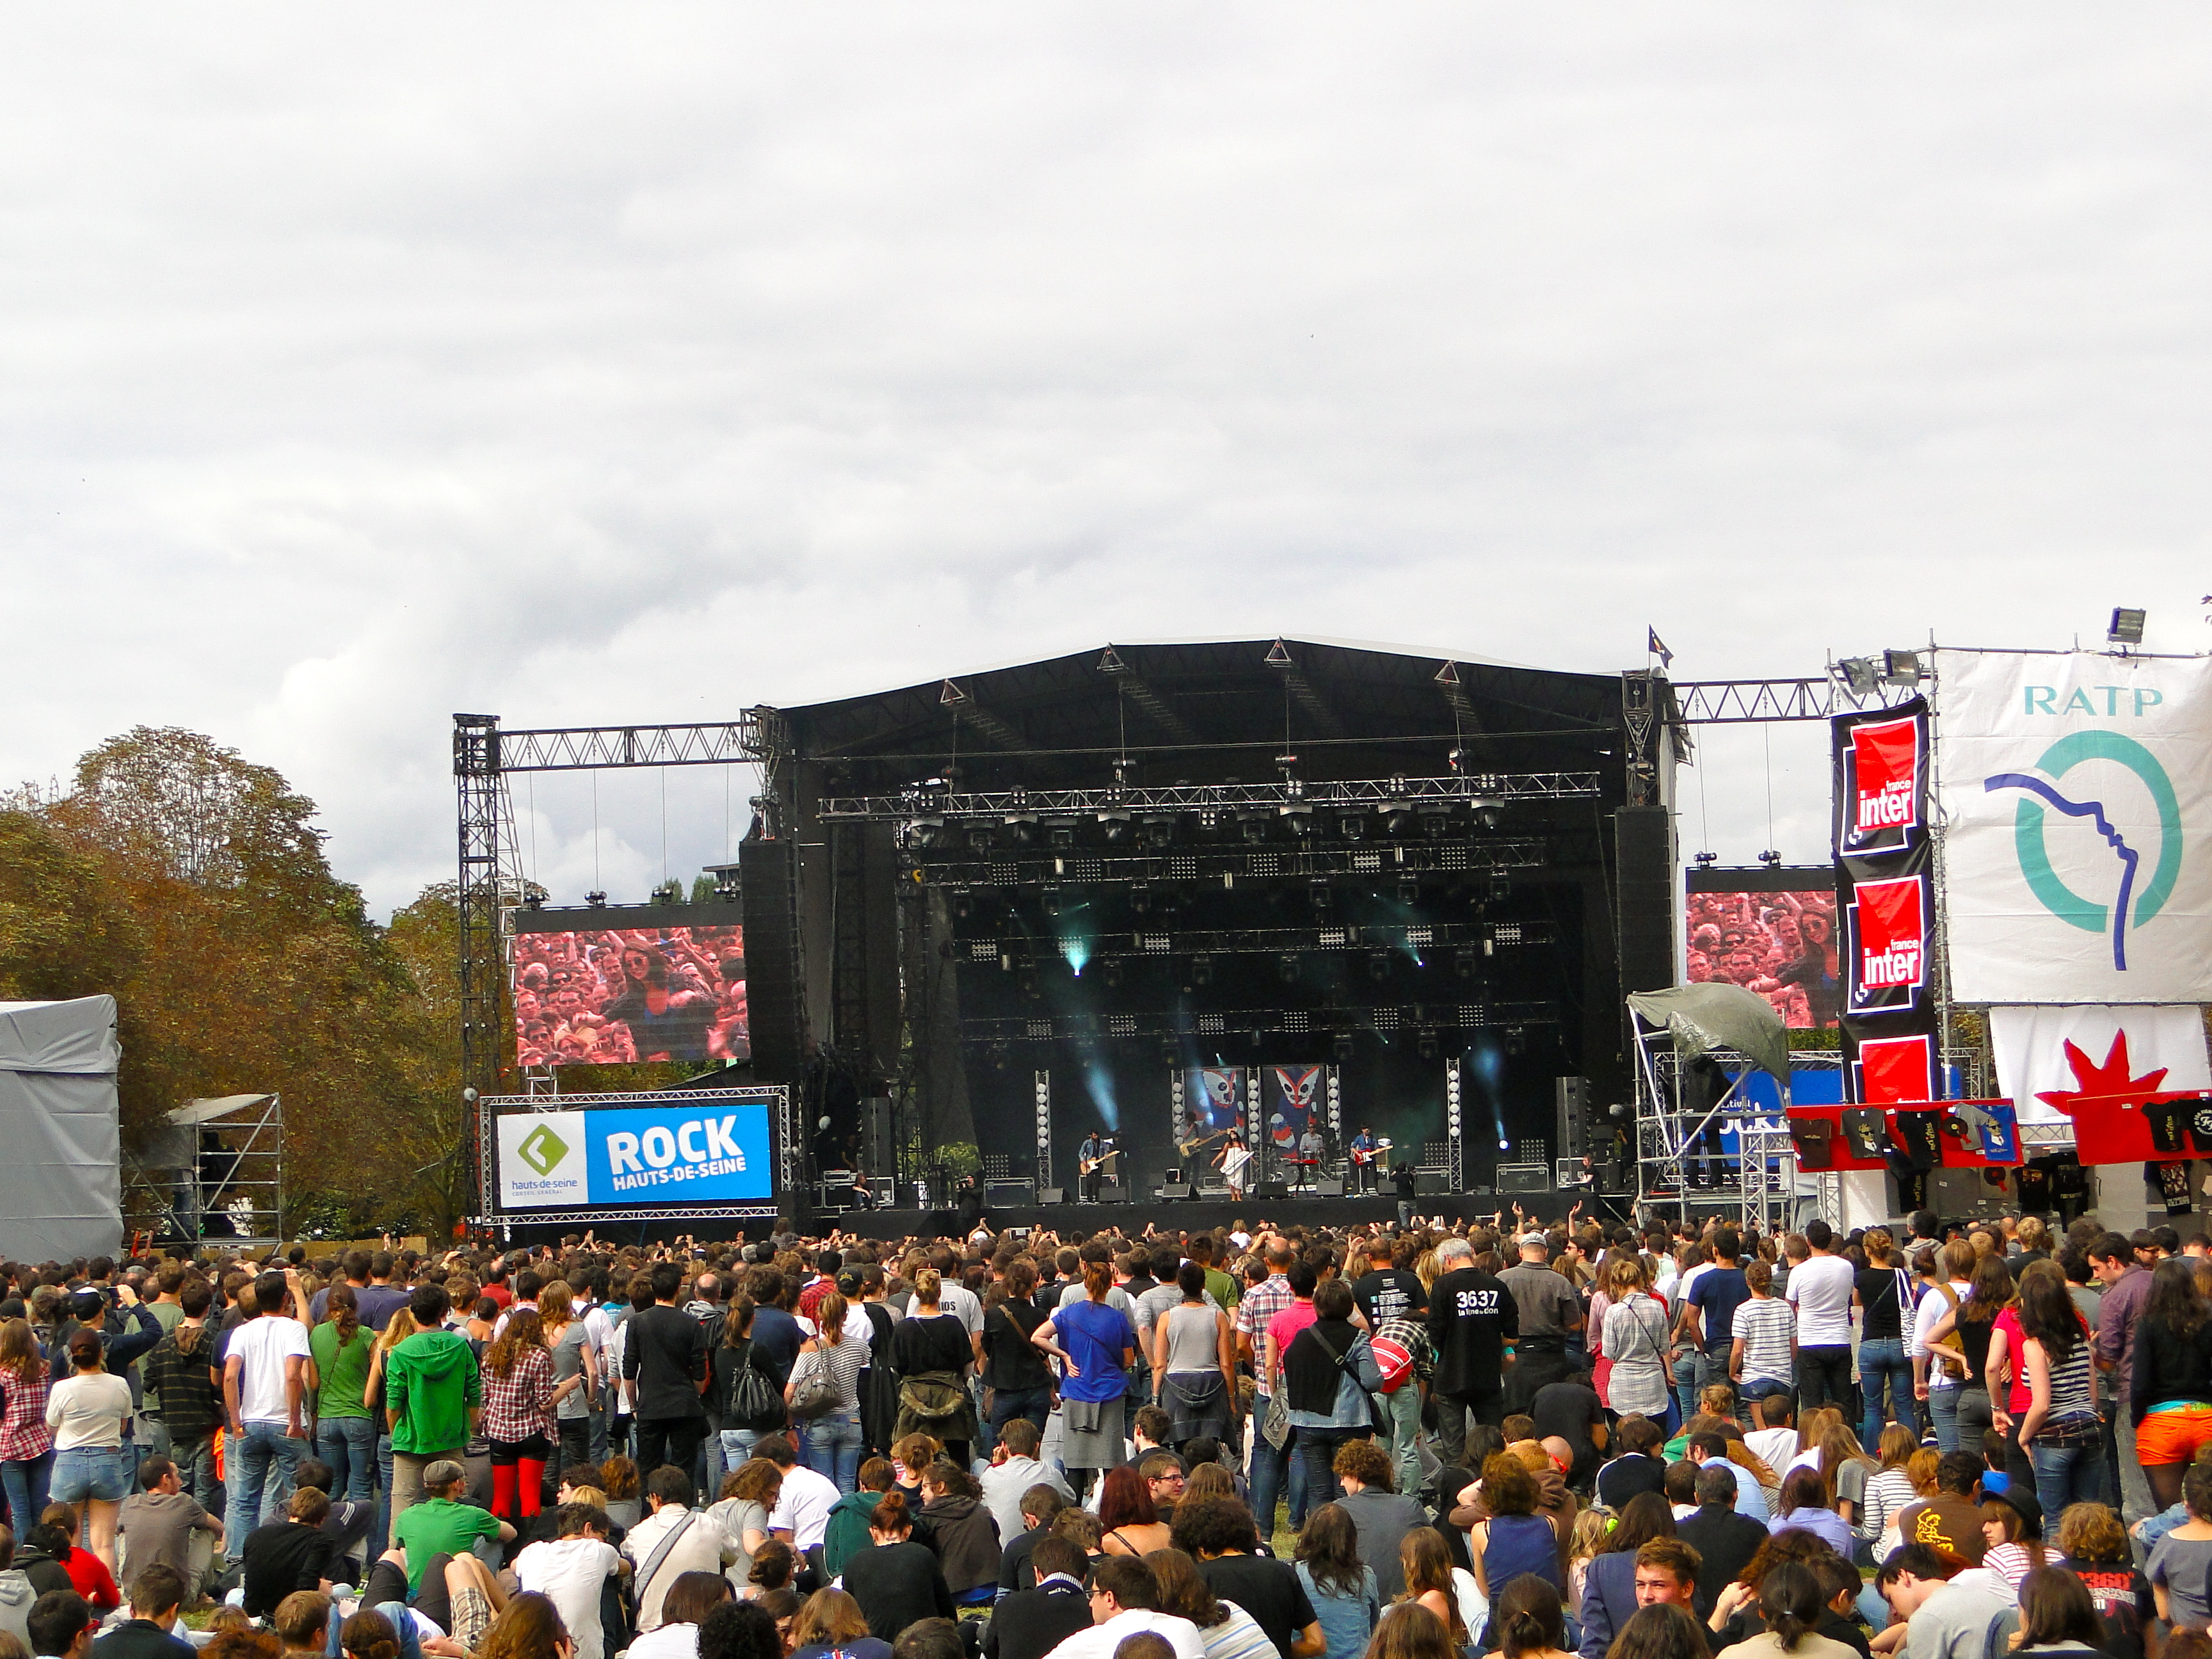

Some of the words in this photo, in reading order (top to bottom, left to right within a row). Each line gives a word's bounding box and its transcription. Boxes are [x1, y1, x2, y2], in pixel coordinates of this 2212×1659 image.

[2024, 686, 2163, 717] RATP
[1886, 780, 1911, 792] france
[1859, 788, 1911, 827] inter
[1890, 939, 1919, 951] france
[1864, 947, 1918, 985] inter
[607, 1115, 744, 1175] ROCK
[512, 1178, 577, 1190] hauts-de-seine
[613, 1157, 747, 1191] HAUTS-DE-SEINE
[1456, 1290, 1498, 1308] 3637
[1484, 1306, 1498, 1315] don
